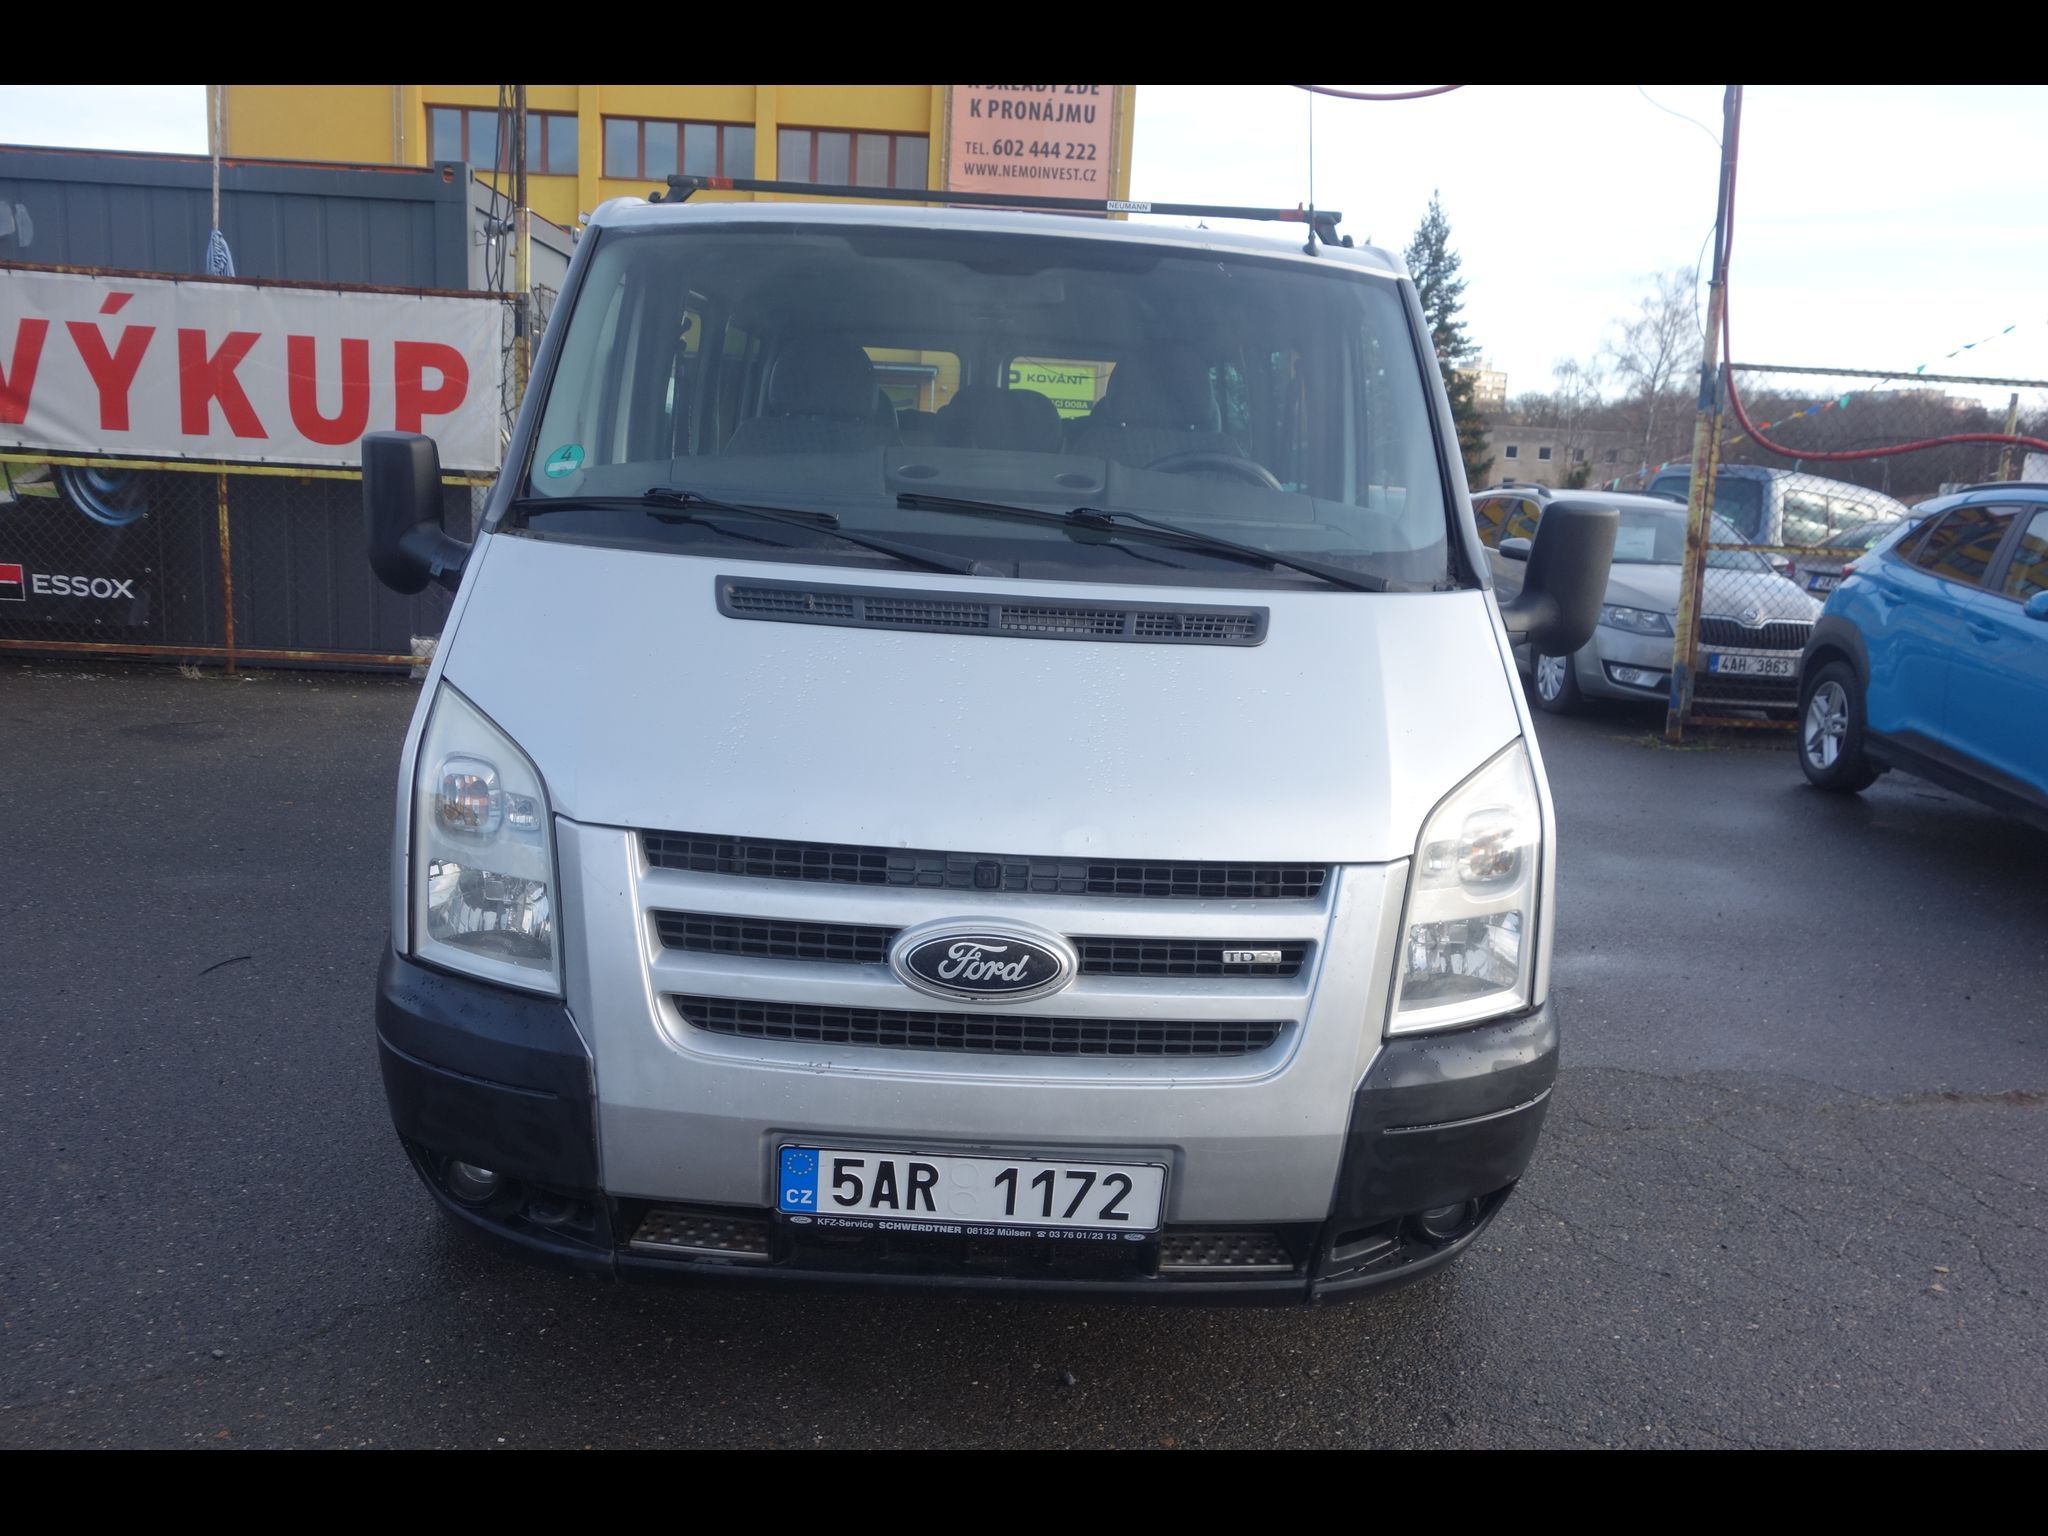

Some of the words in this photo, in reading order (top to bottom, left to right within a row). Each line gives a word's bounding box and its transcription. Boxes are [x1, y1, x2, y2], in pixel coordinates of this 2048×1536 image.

[970, 98, 982, 118] K
[987, 98, 1096, 124] PRONÁJMU
[965, 141, 989, 156] TEL.
[992, 139, 1024, 157] 602
[1029, 141, 1060, 159] 444
[1065, 143, 1096, 161] 222
[963, 162, 1097, 182] WWW.NEMOINVEST.CZ
[1108, 202, 1148, 211] NEUMANN
[0, 292, 469, 446] VÝKUP
[560, 446, 573, 461] 4
[32, 574, 135, 599] ESSOX
[1720, 655, 1747, 671] 4AH
[937, 942, 1028, 982] Ford
[786, 1188, 813, 1204] CZ
[832, 1157, 940, 1212] 5AR
[994, 1167, 1134, 1221] 1172
[817, 1217, 874, 1229] KFZ-Service
[878, 1221, 962, 1234] SCHWERDTNER
[966, 1227, 995, 1236] 08132
[997, 1228, 1031, 1237] Mülsen
[1049, 1231, 1060, 1239] 03
[1062, 1231, 1074, 1239] 76
[1076, 1231, 1103, 1240] 01/23
[1106, 1232, 1117, 1241] 13
